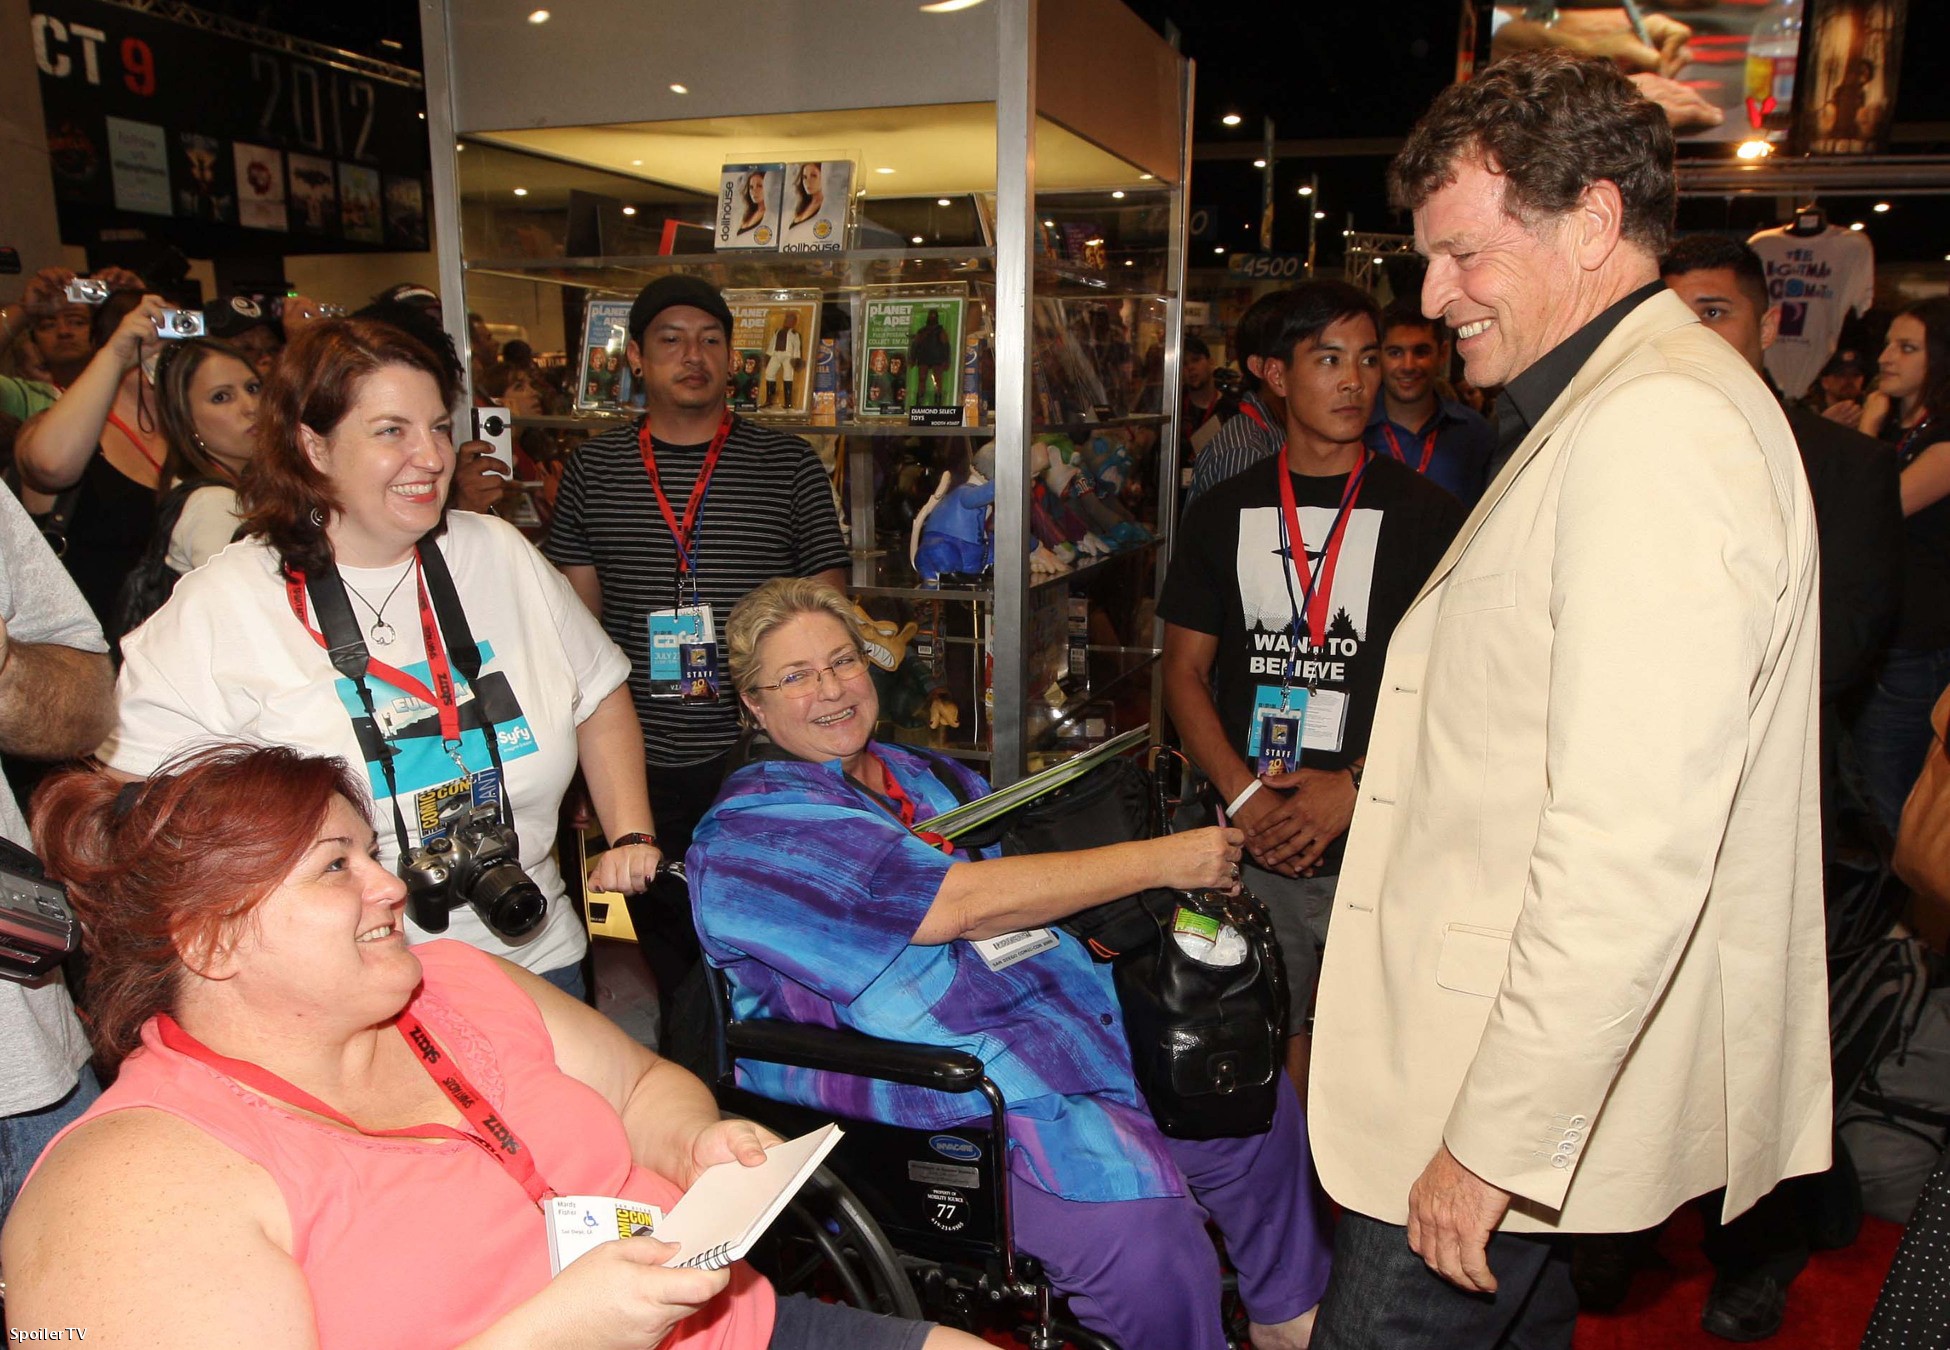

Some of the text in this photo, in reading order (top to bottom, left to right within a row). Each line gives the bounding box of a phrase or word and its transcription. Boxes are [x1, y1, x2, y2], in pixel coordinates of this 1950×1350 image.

[120, 36, 156, 97] 9
[251, 53, 378, 162] 2012
[720, 181, 734, 241] dollhouse
[783, 242, 840, 252] dollhouse
[1243, 257, 1299, 277] 4500
[1328, 637, 1358, 657] TO
[686, 671, 712, 679] STAFF
[497, 725, 531, 747] Syfy
[1265, 748, 1292, 758] STAFF
[437, 779, 471, 799] CON
[419, 791, 439, 829] COMIC
[629, 1211, 653, 1227] CON
[936, 1203, 956, 1219] 77
[617, 1208, 632, 1239] OMIC
